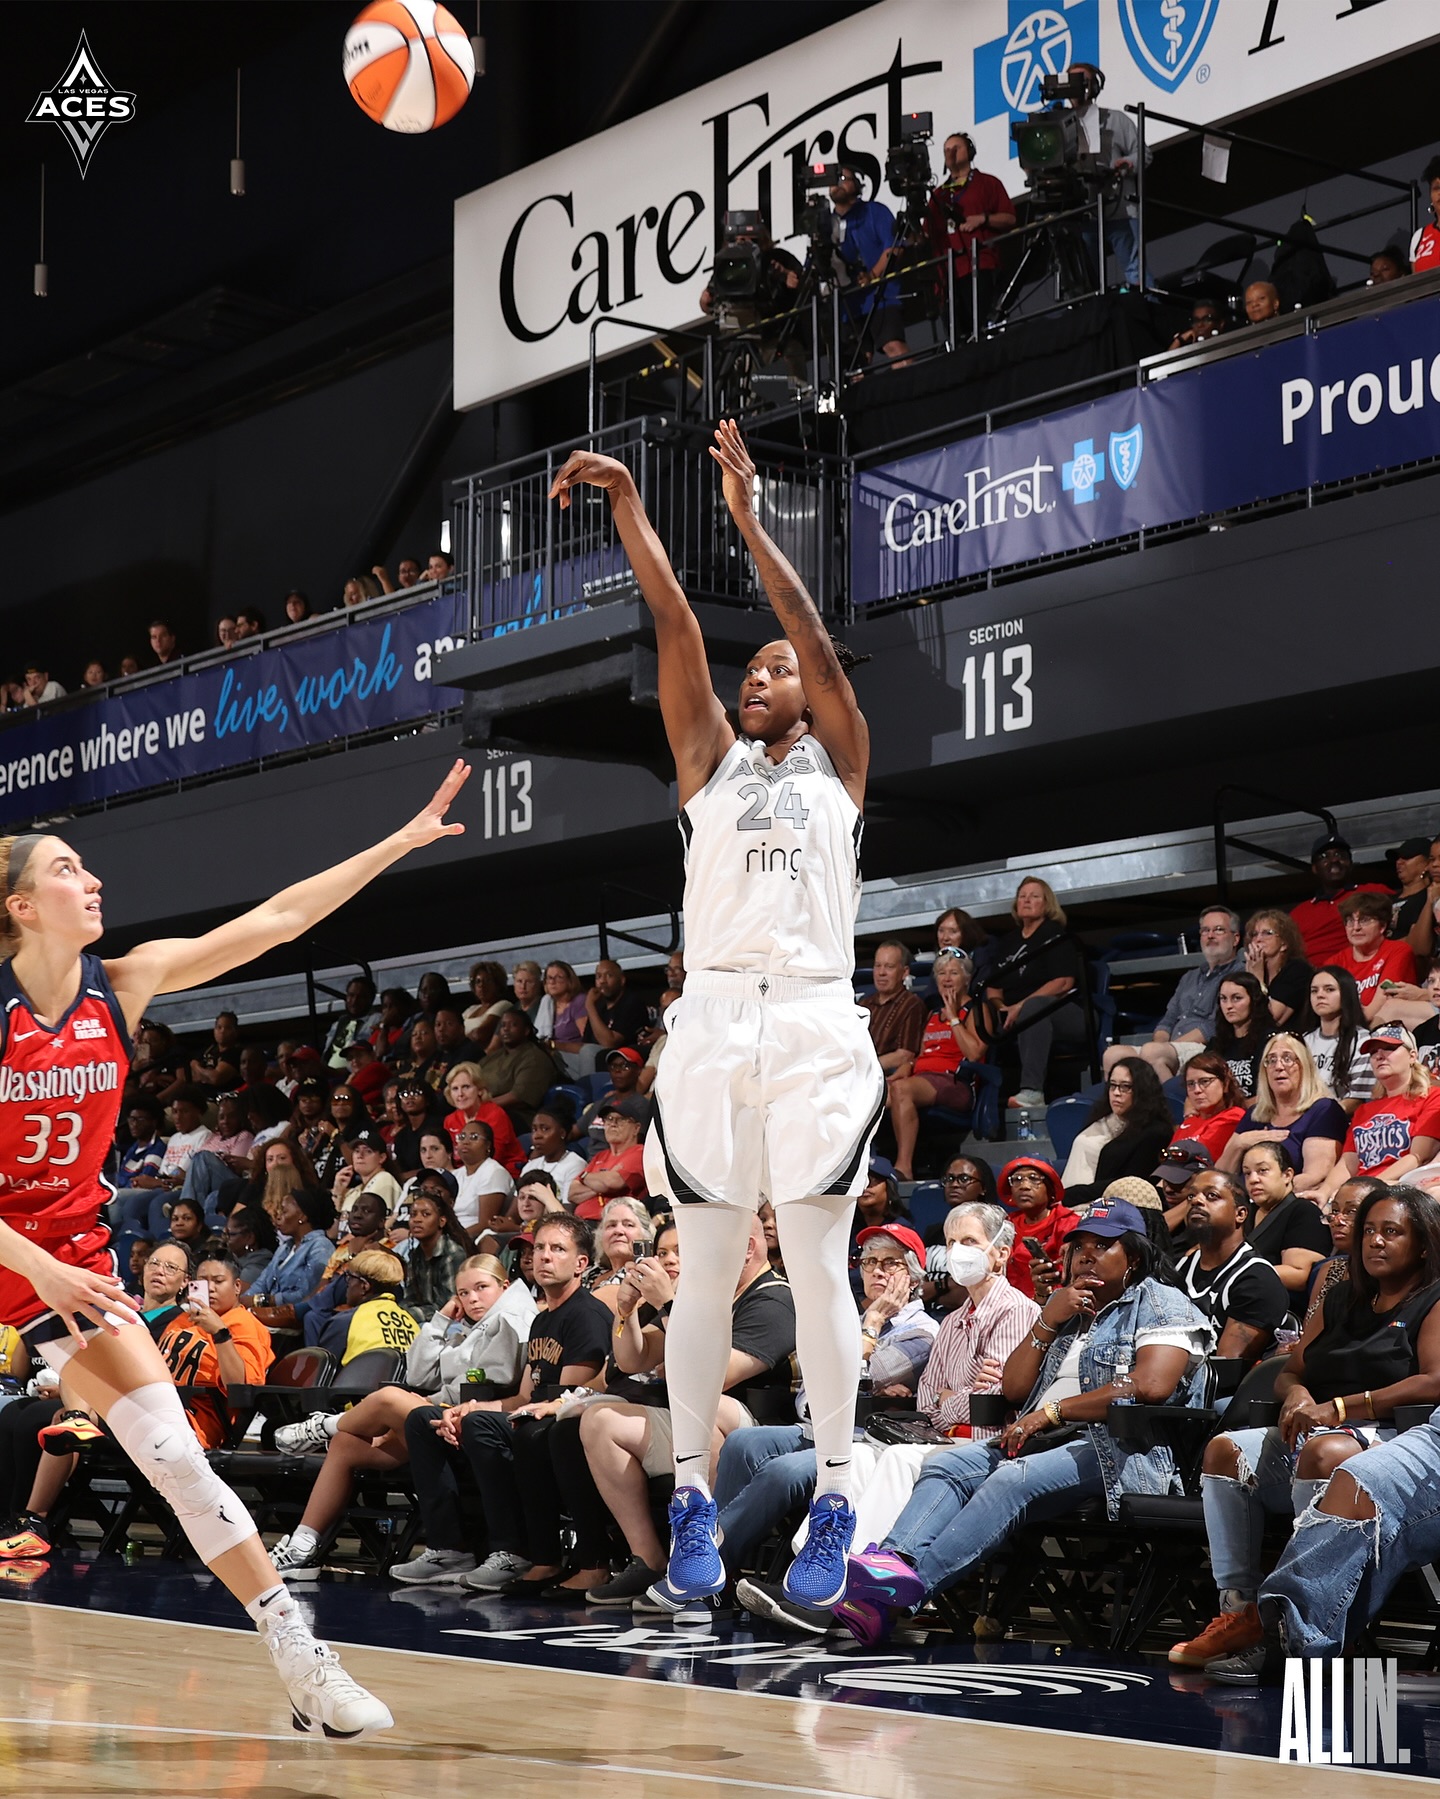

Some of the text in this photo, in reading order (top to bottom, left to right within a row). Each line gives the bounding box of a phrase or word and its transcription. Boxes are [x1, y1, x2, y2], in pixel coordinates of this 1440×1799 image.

[500, 38, 942, 342] CareFirst
[968, 619, 1024, 646] SECTION
[80, 721, 159, 772] where
[166, 708, 206, 748] we
[297, 623, 403, 714] work
[962, 643, 1033, 740] 113
[728, 756, 815, 784] ACES
[482, 760, 532, 839] 113
[737, 782, 809, 831] 24
[746, 842, 802, 880] ring
[16, 1111, 83, 1166] 33
[377, 1311, 413, 1329] CSC
[381, 1328, 415, 1346] EVENT
